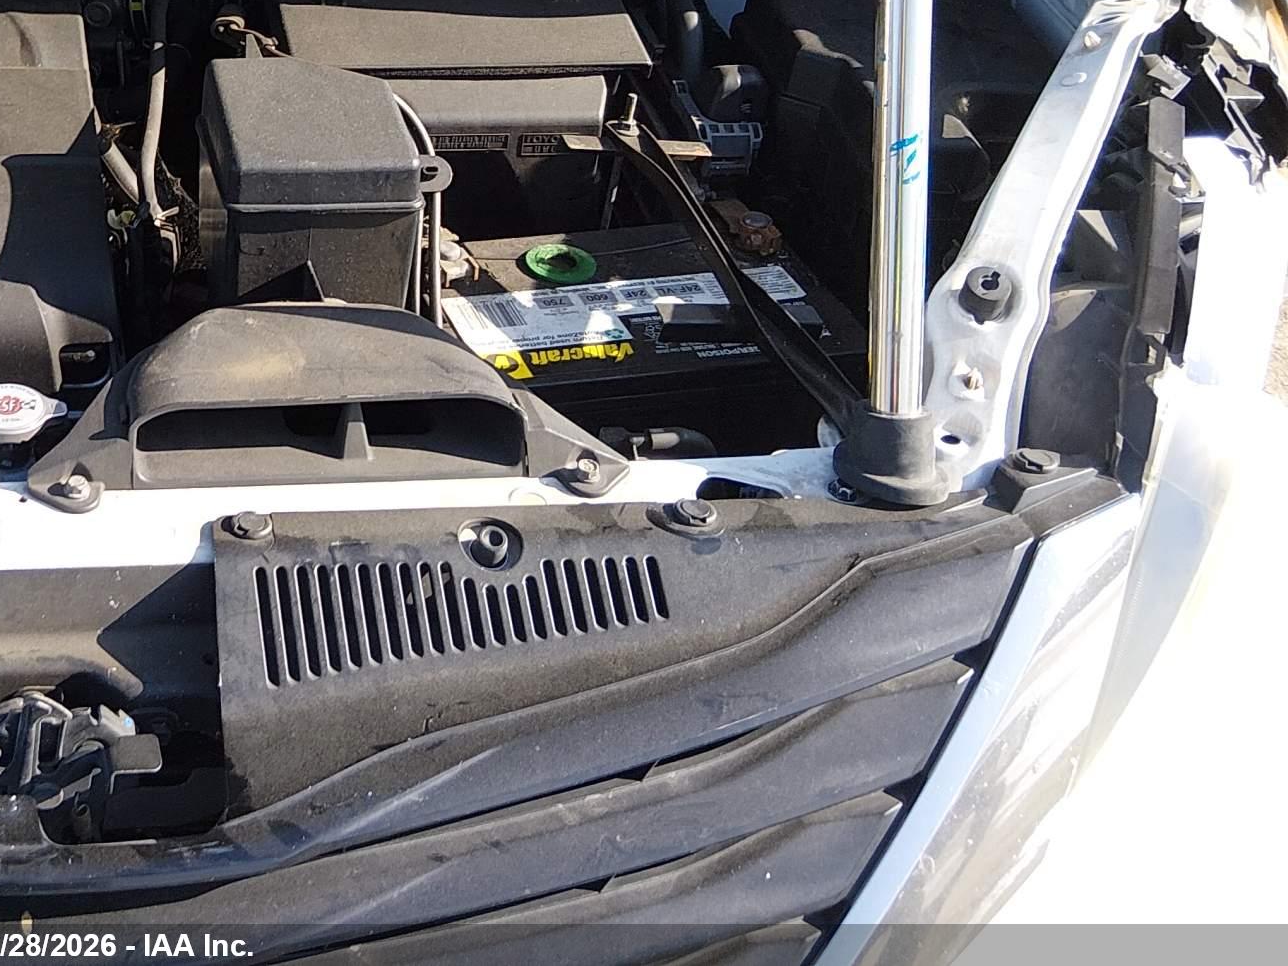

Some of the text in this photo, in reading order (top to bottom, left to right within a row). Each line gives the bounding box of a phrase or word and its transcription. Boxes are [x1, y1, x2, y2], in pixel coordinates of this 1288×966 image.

[624, 289, 648, 299] 24F
[657, 284, 702, 296] 24F-VL
[543, 298, 565, 307] 750
[586, 293, 609, 303] 600
[548, 338, 571, 346] used
[528, 342, 635, 366] Valucraft
